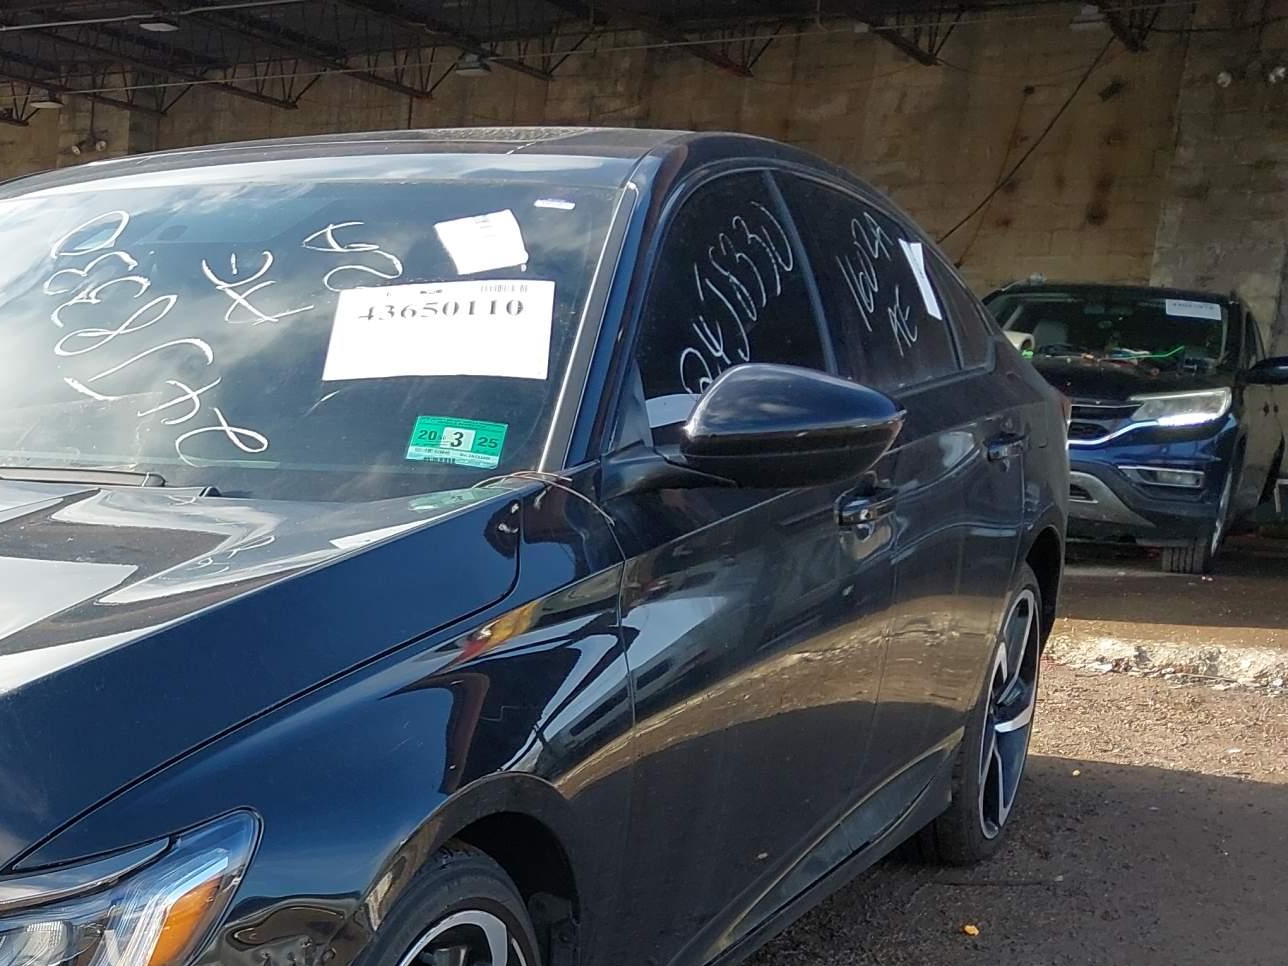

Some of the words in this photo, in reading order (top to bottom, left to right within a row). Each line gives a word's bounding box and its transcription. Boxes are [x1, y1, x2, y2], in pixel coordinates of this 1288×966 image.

[358, 299, 524, 321] 43650110
[418, 429, 438, 441] 20
[450, 431, 464, 448] 3
[477, 436, 499, 449] 25
